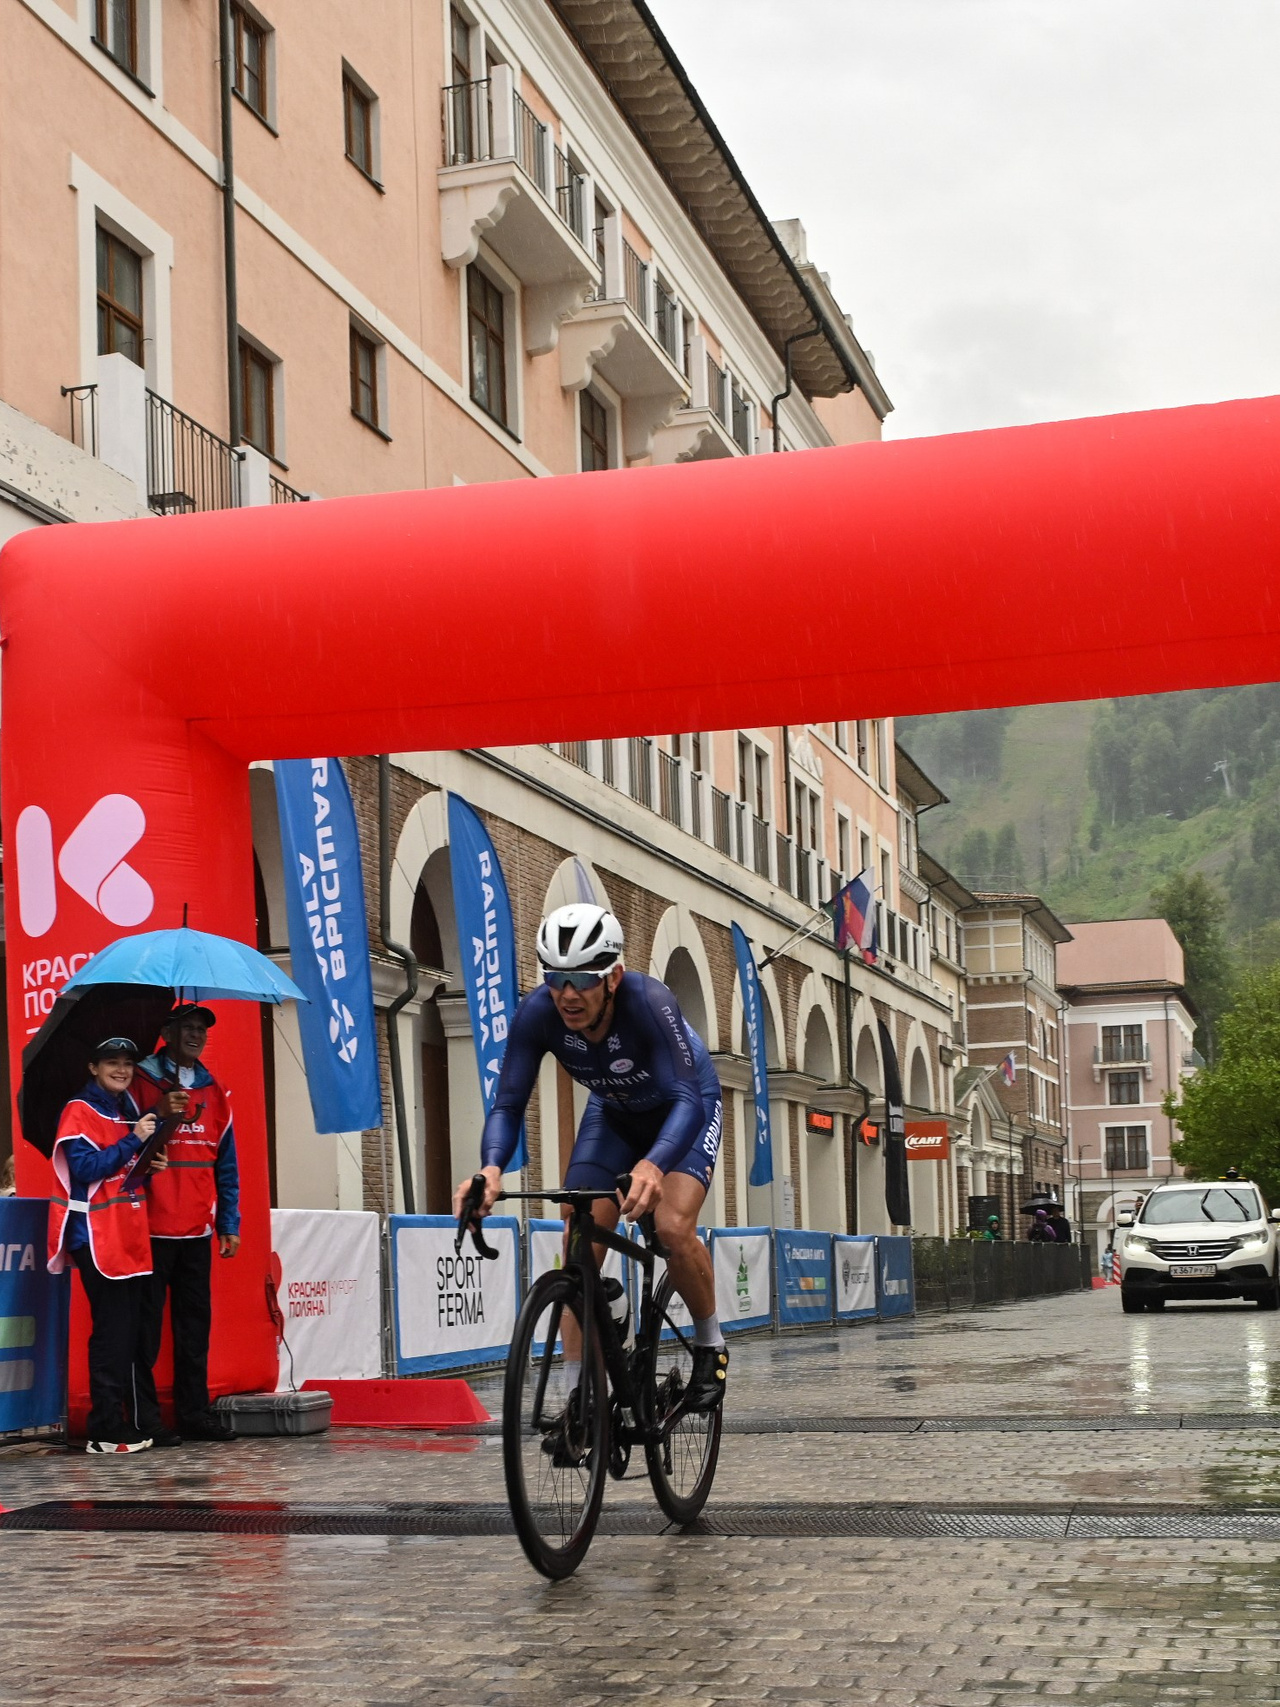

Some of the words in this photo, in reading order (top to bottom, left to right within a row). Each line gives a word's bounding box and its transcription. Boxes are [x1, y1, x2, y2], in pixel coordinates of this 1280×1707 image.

[22, 951, 95, 990] КРАС
[661, 1005, 694, 1067] ПАНАВТО
[908, 1136, 944, 1146] КАНТ
[287, 1280, 327, 1299] КРАСНАЯ
[435, 1254, 484, 1291] SPORT
[288, 1300, 326, 1318] ПОЛЯНА
[437, 1290, 486, 1328] FERMA
